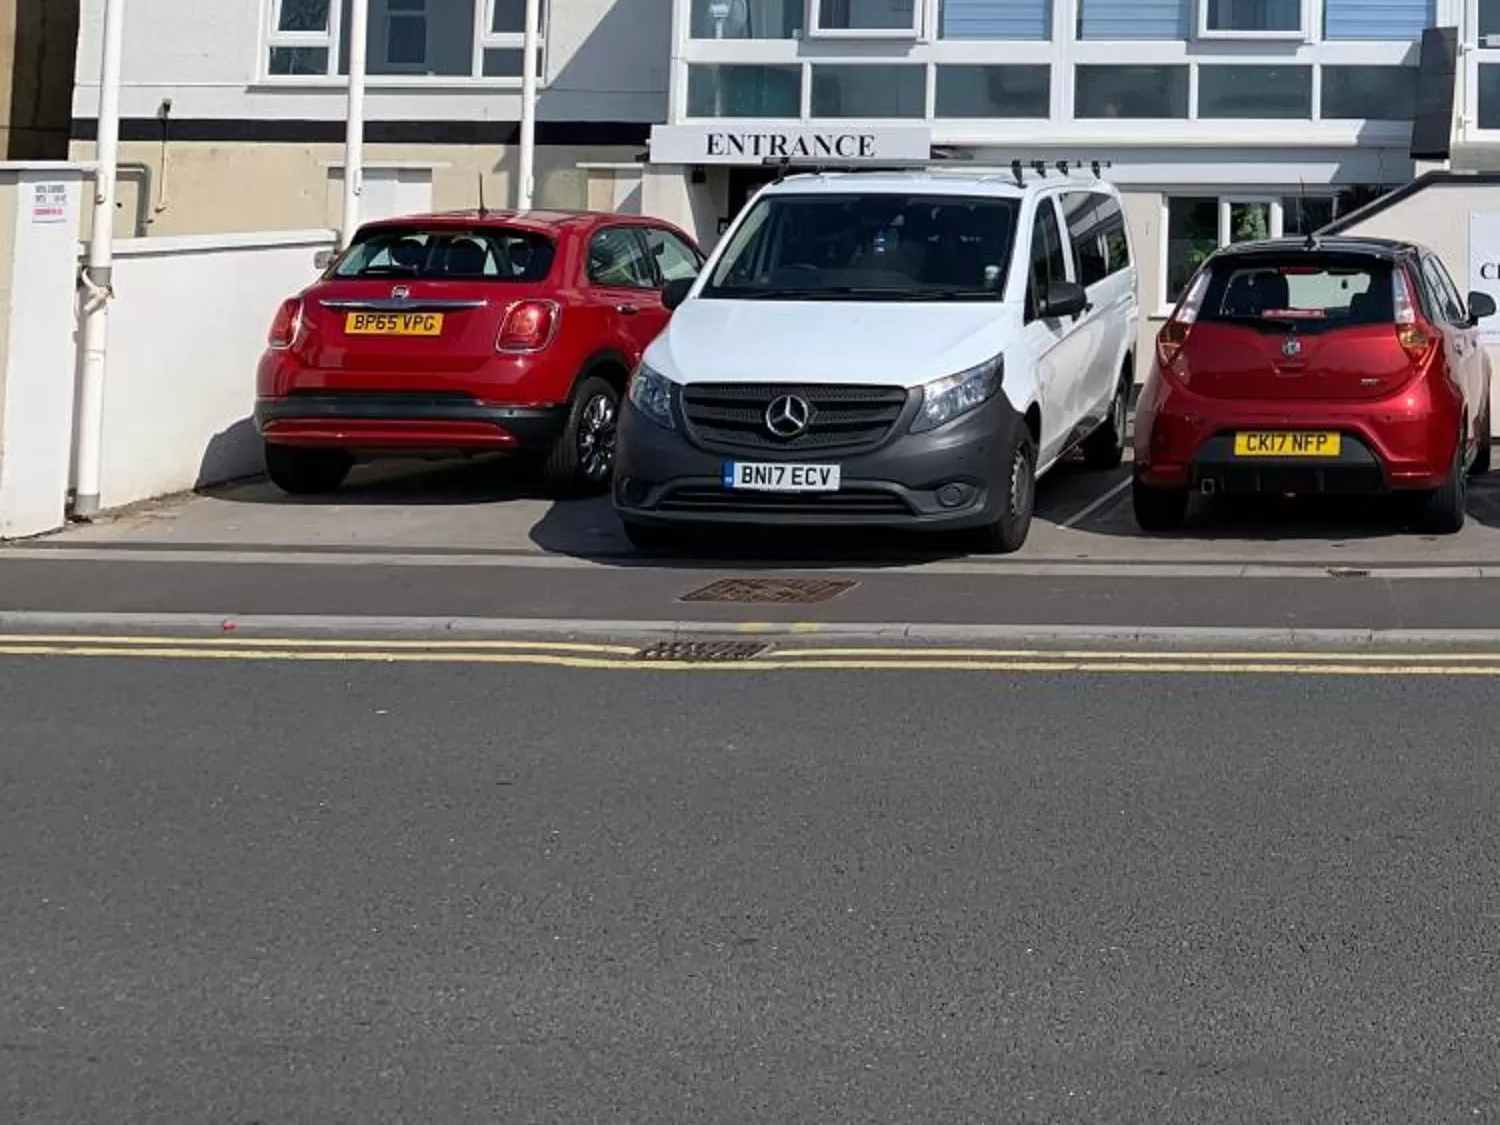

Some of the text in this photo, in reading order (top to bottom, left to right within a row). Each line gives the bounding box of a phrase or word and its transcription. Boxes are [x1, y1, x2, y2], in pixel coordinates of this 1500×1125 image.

[706, 133, 876, 157] ENTRANCE
[353, 315, 435, 331] BP65 VPG
[1247, 434, 1328, 452] CK17 NFP
[741, 466, 831, 485] BN17 ECV
